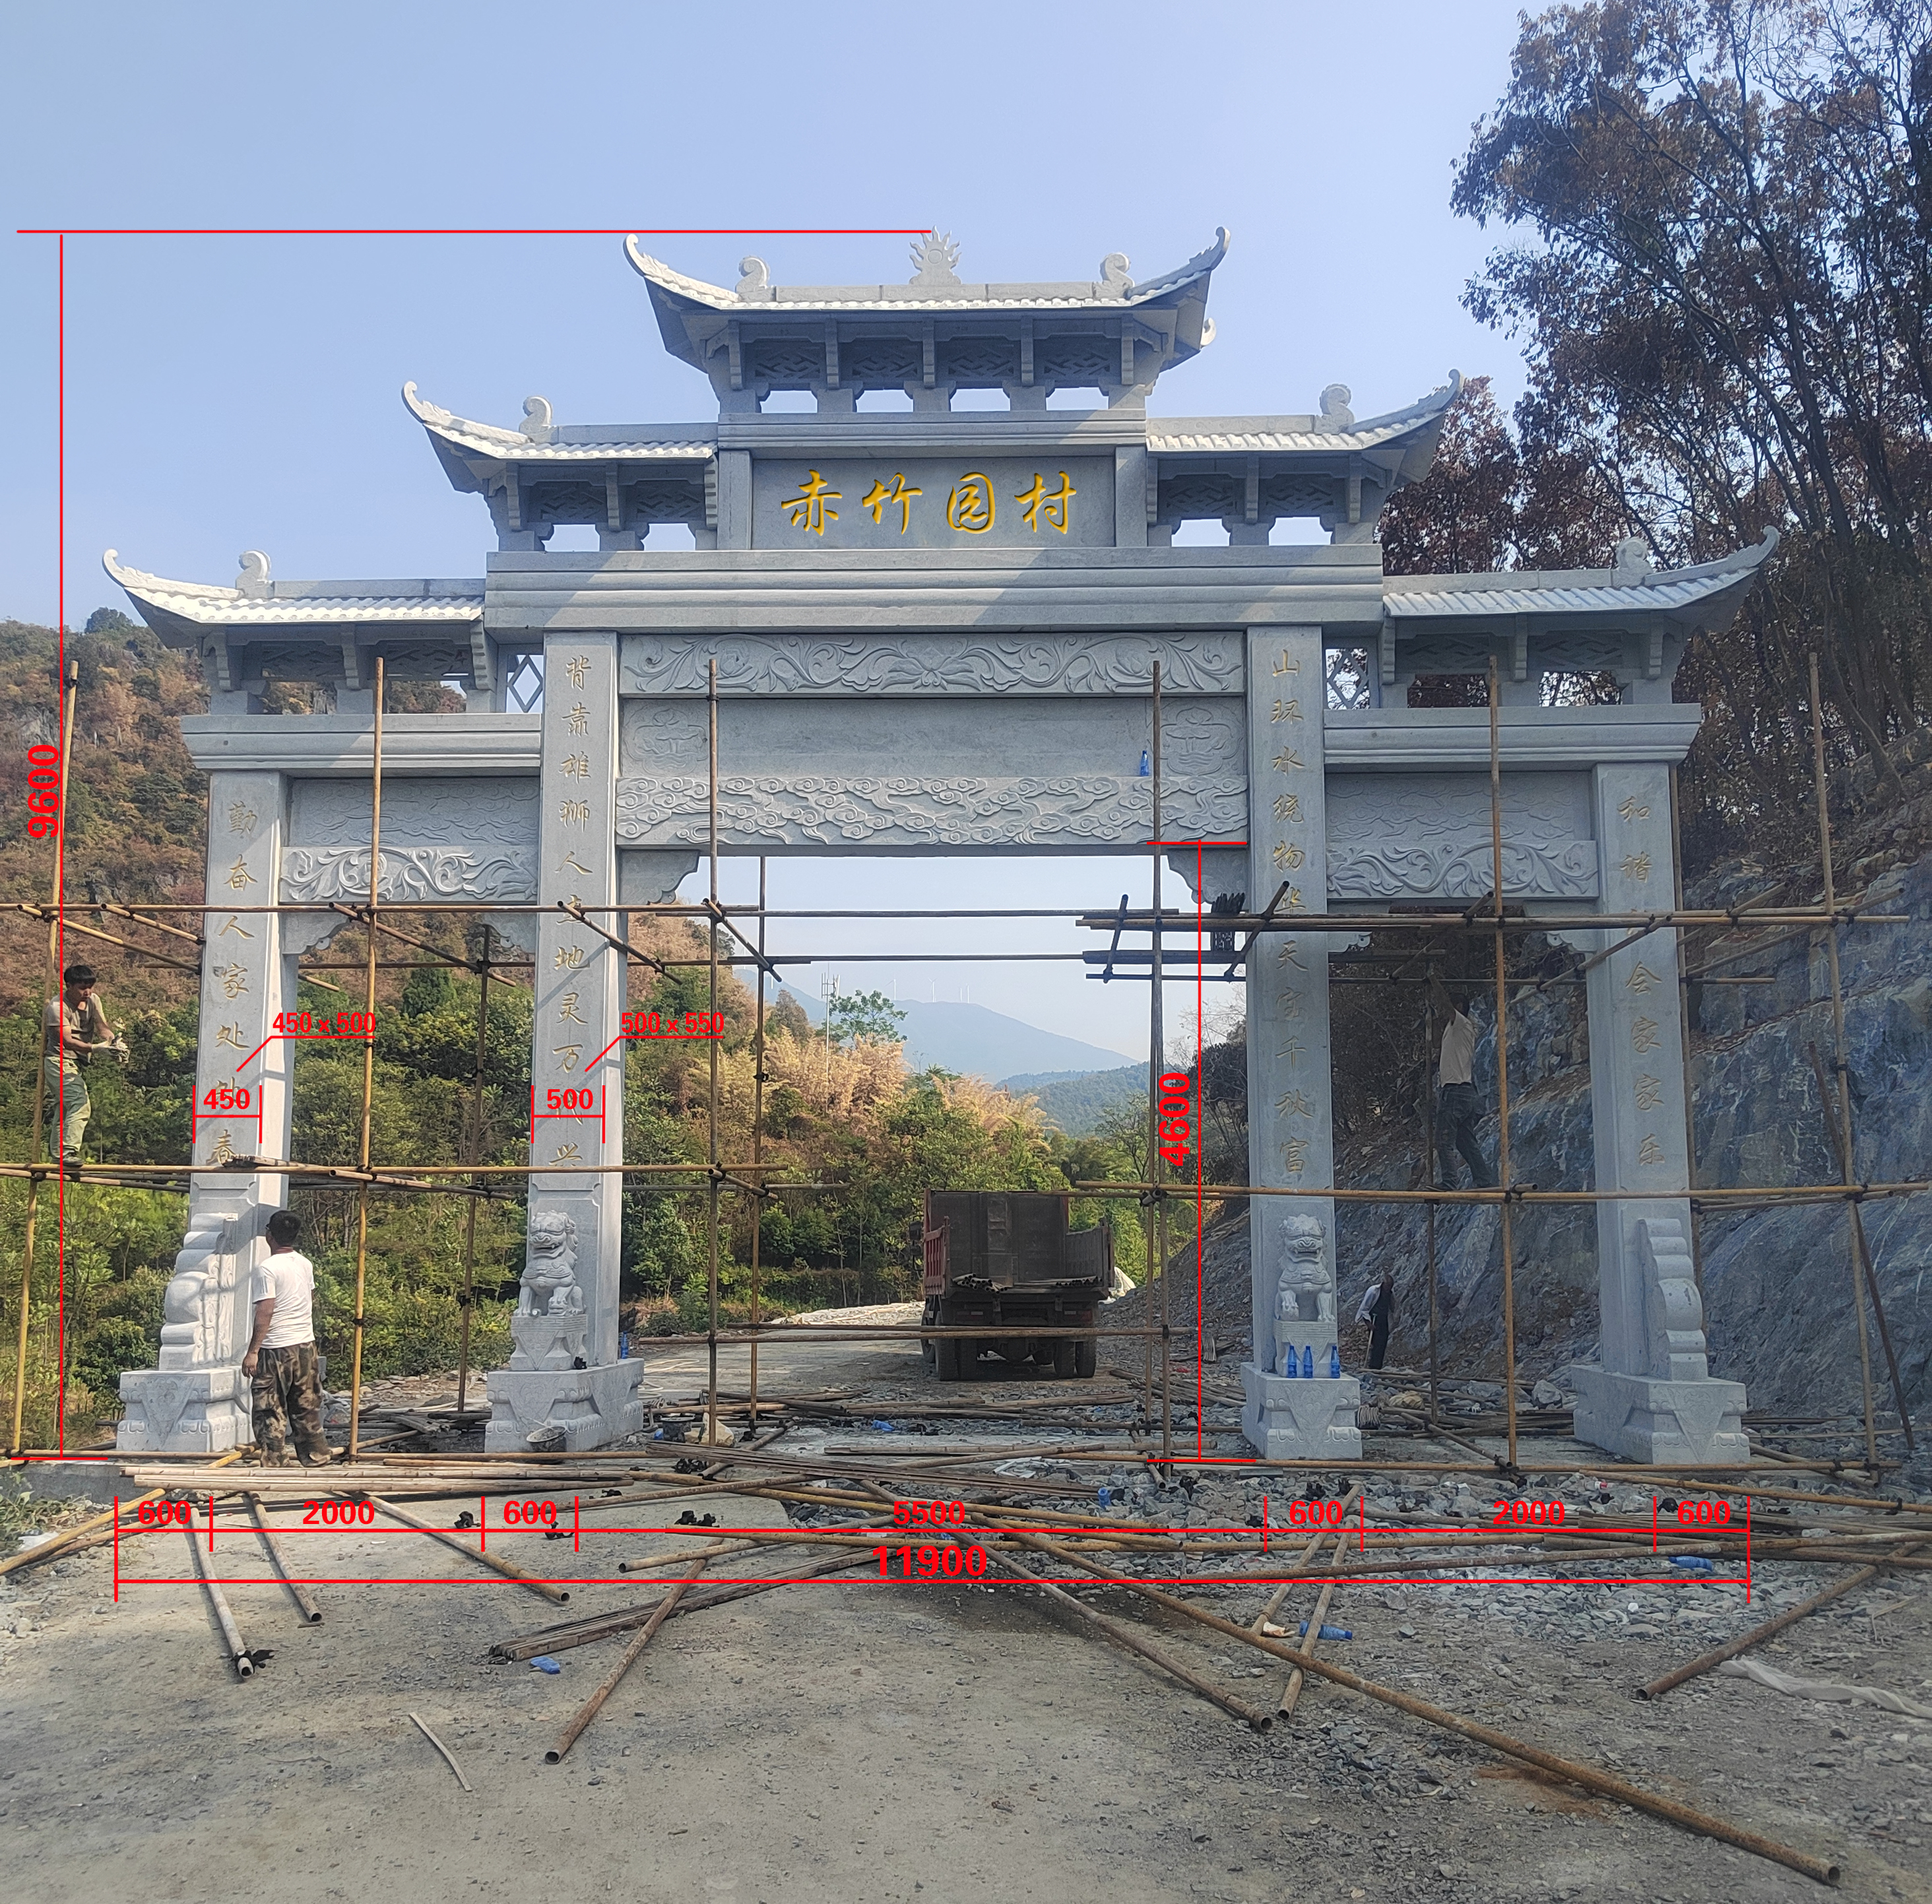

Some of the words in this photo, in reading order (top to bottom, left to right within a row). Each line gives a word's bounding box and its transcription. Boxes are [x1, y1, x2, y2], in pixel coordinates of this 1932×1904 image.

[781, 469, 1076, 536] 赤竹园村
[1617, 796, 1665, 1166] 和谐会家家乐
